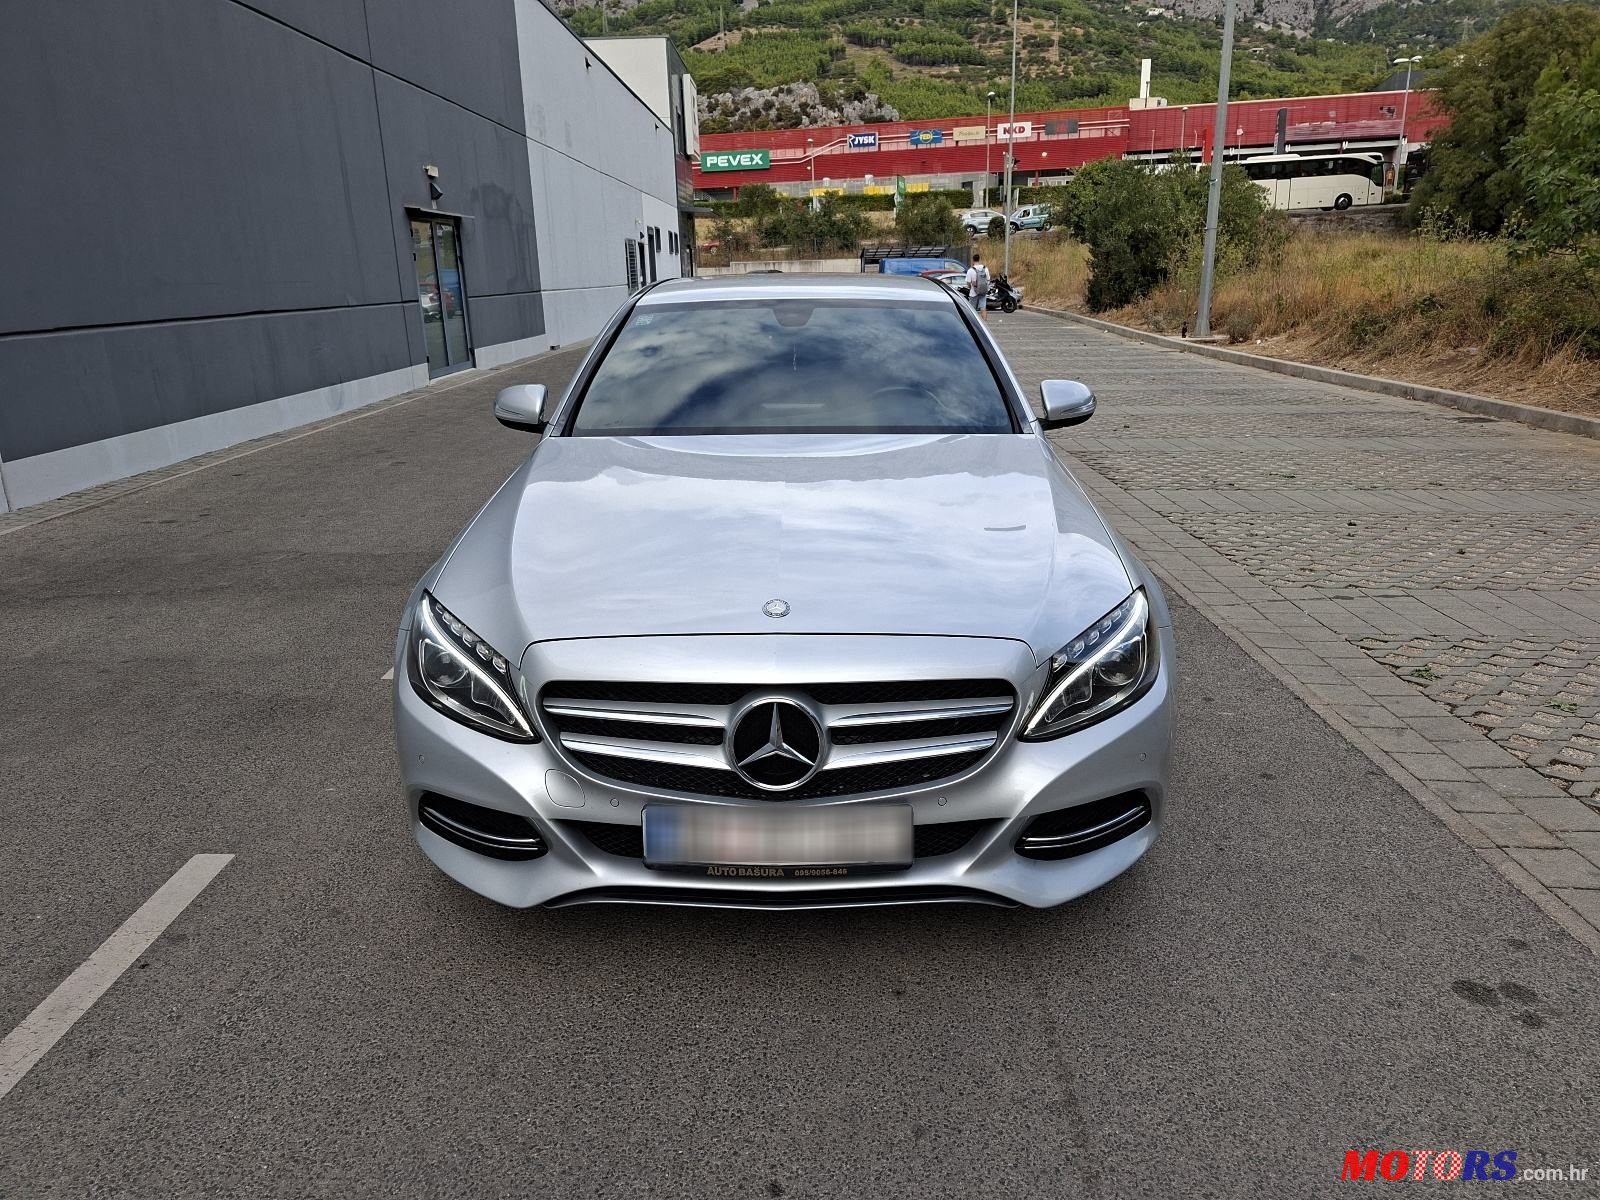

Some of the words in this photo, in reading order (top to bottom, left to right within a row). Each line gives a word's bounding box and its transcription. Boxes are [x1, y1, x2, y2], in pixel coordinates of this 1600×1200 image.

[1003, 126, 1026, 135] NKD
[853, 135, 875, 145] JYSK
[706, 152, 764, 168] PEVEX
[707, 866, 737, 876] AUTO
[738, 866, 785, 877] BAŠURA
